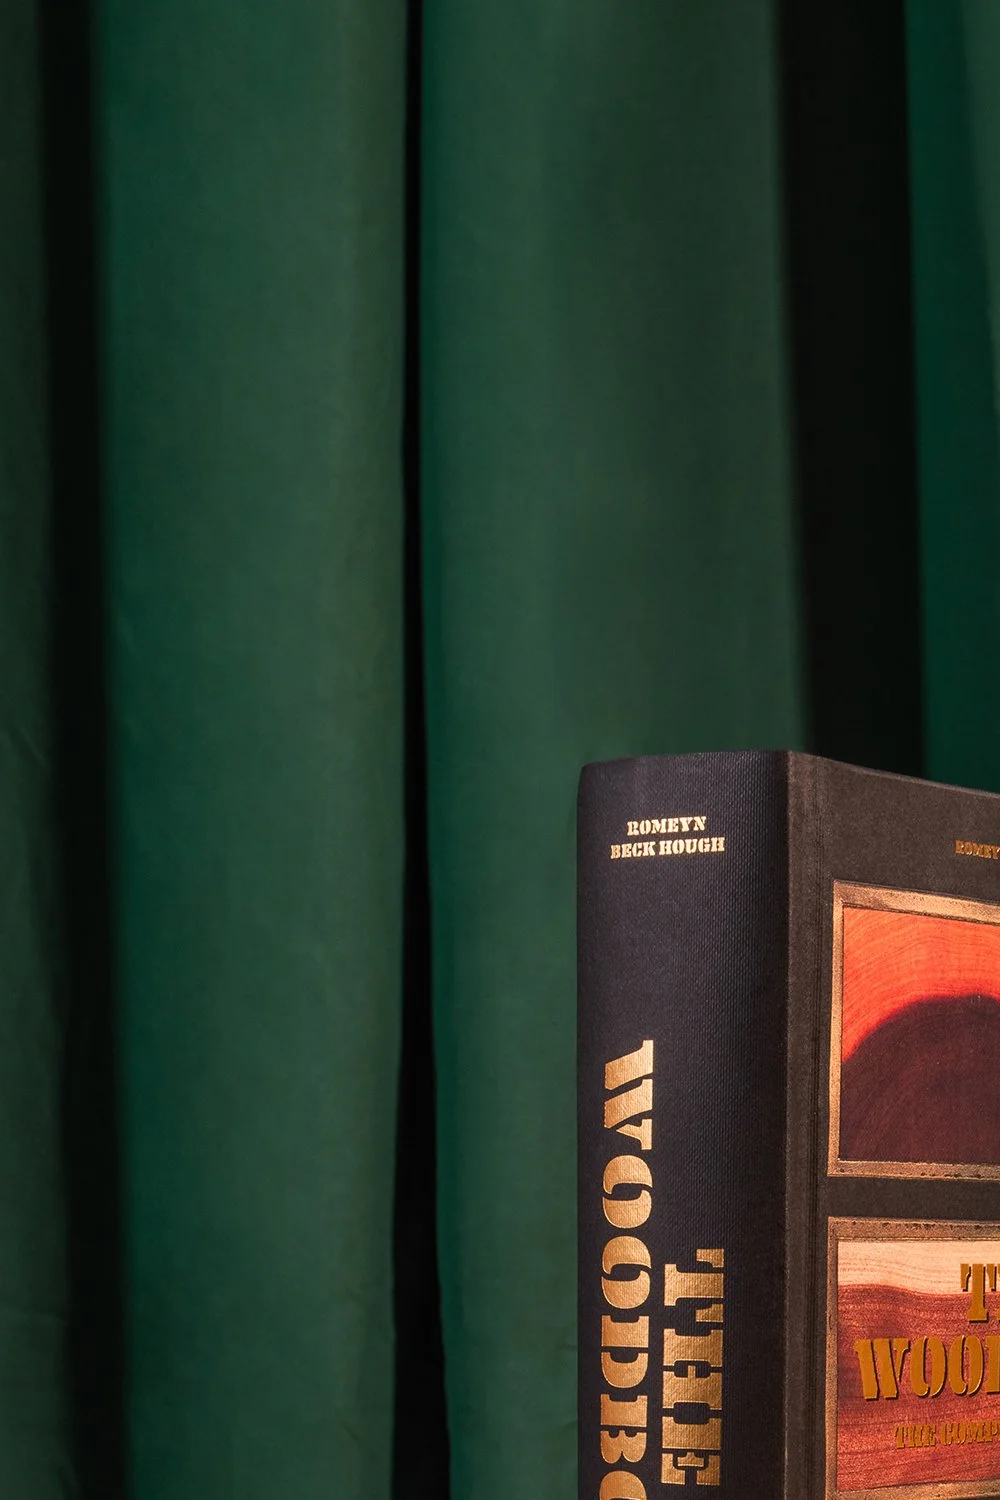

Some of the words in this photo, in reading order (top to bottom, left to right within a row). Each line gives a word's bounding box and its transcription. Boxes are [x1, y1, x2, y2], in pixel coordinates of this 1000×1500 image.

[627, 816, 707, 836] ROMEYN
[610, 841, 656, 859] BECK
[659, 837, 725, 855] HOUGH
[661, 1248, 725, 1486] THE
[894, 1424, 936, 1449] THE
